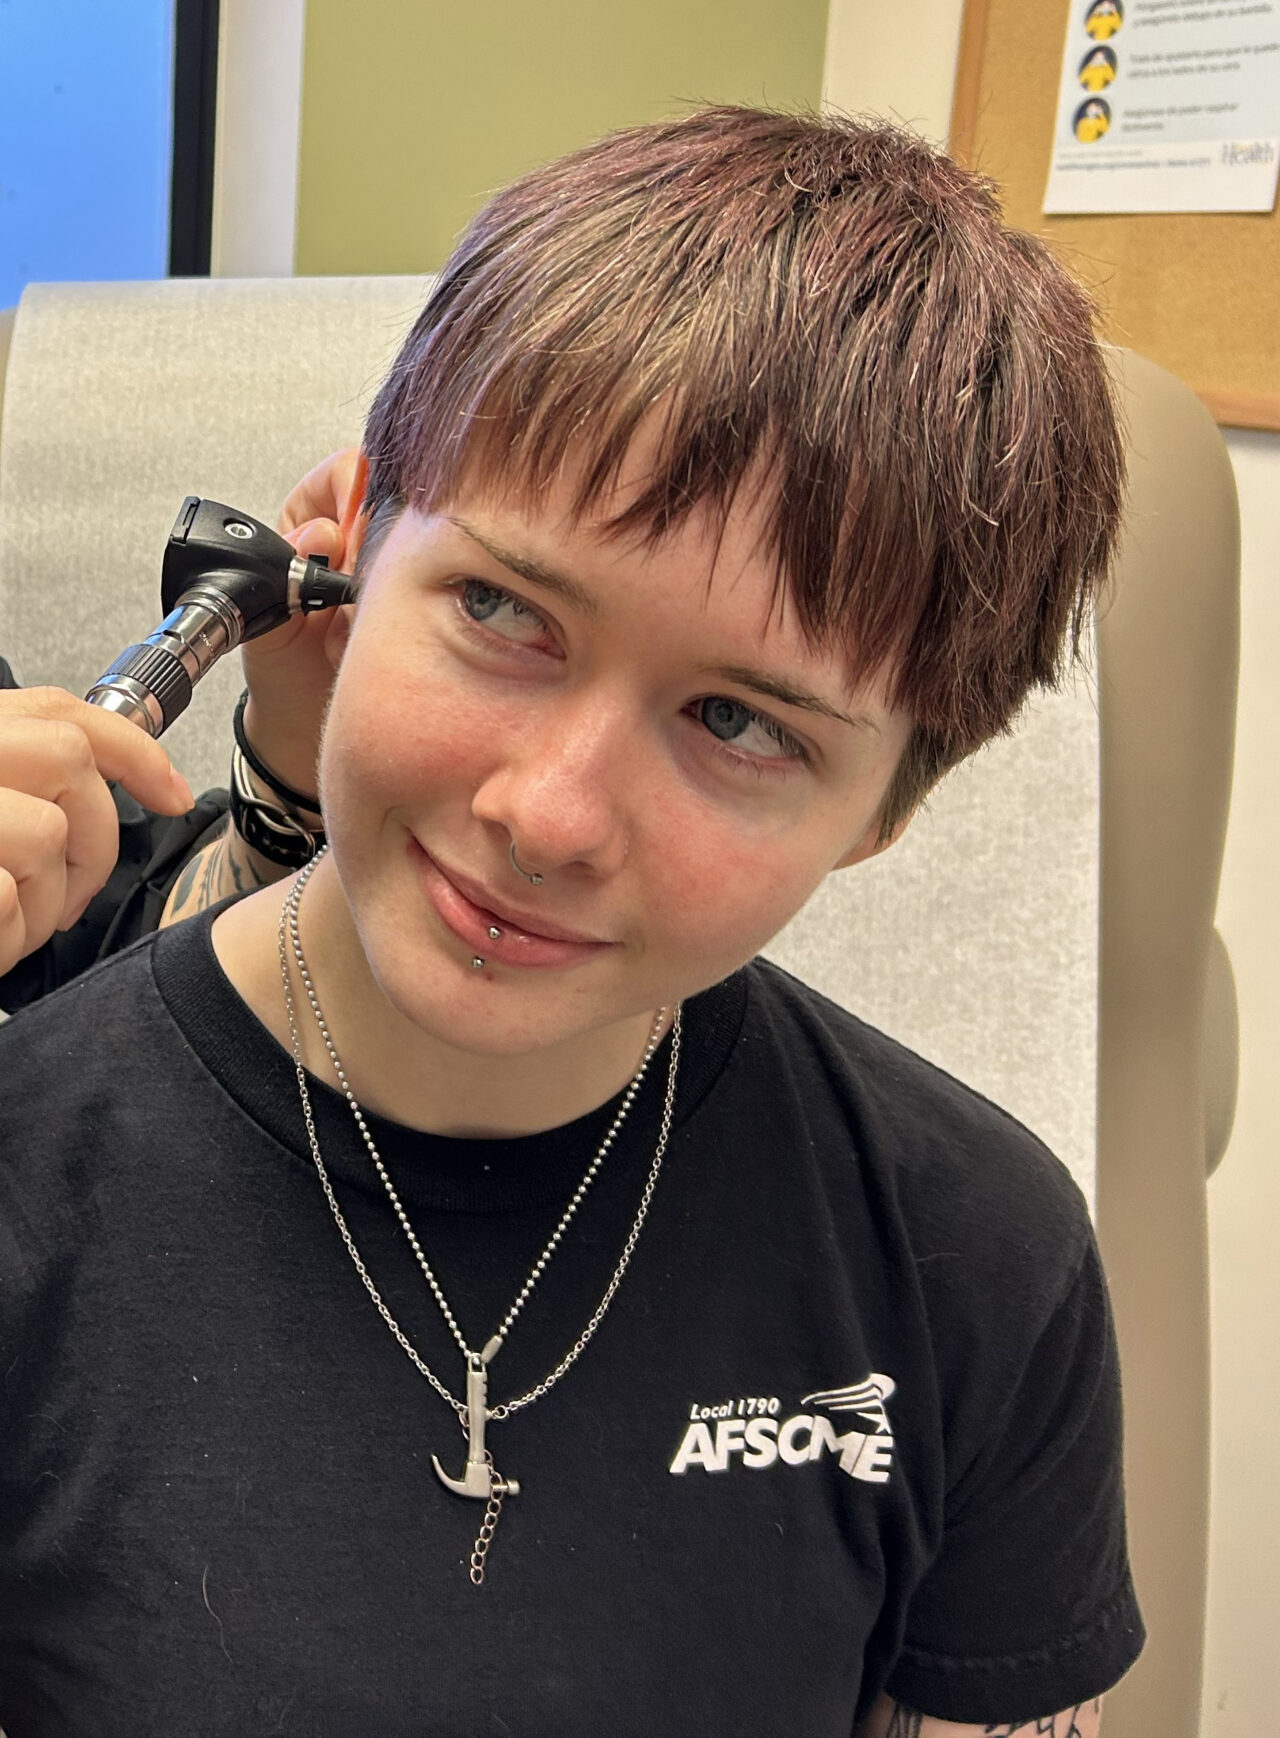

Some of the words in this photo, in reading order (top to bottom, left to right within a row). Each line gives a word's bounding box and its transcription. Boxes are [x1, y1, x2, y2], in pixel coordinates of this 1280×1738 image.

[1222, 142, 1274, 166] Health
[689, 1400, 734, 1420] Local
[737, 1397, 780, 1415] 1790
[670, 1415, 894, 1483] AFSCME
